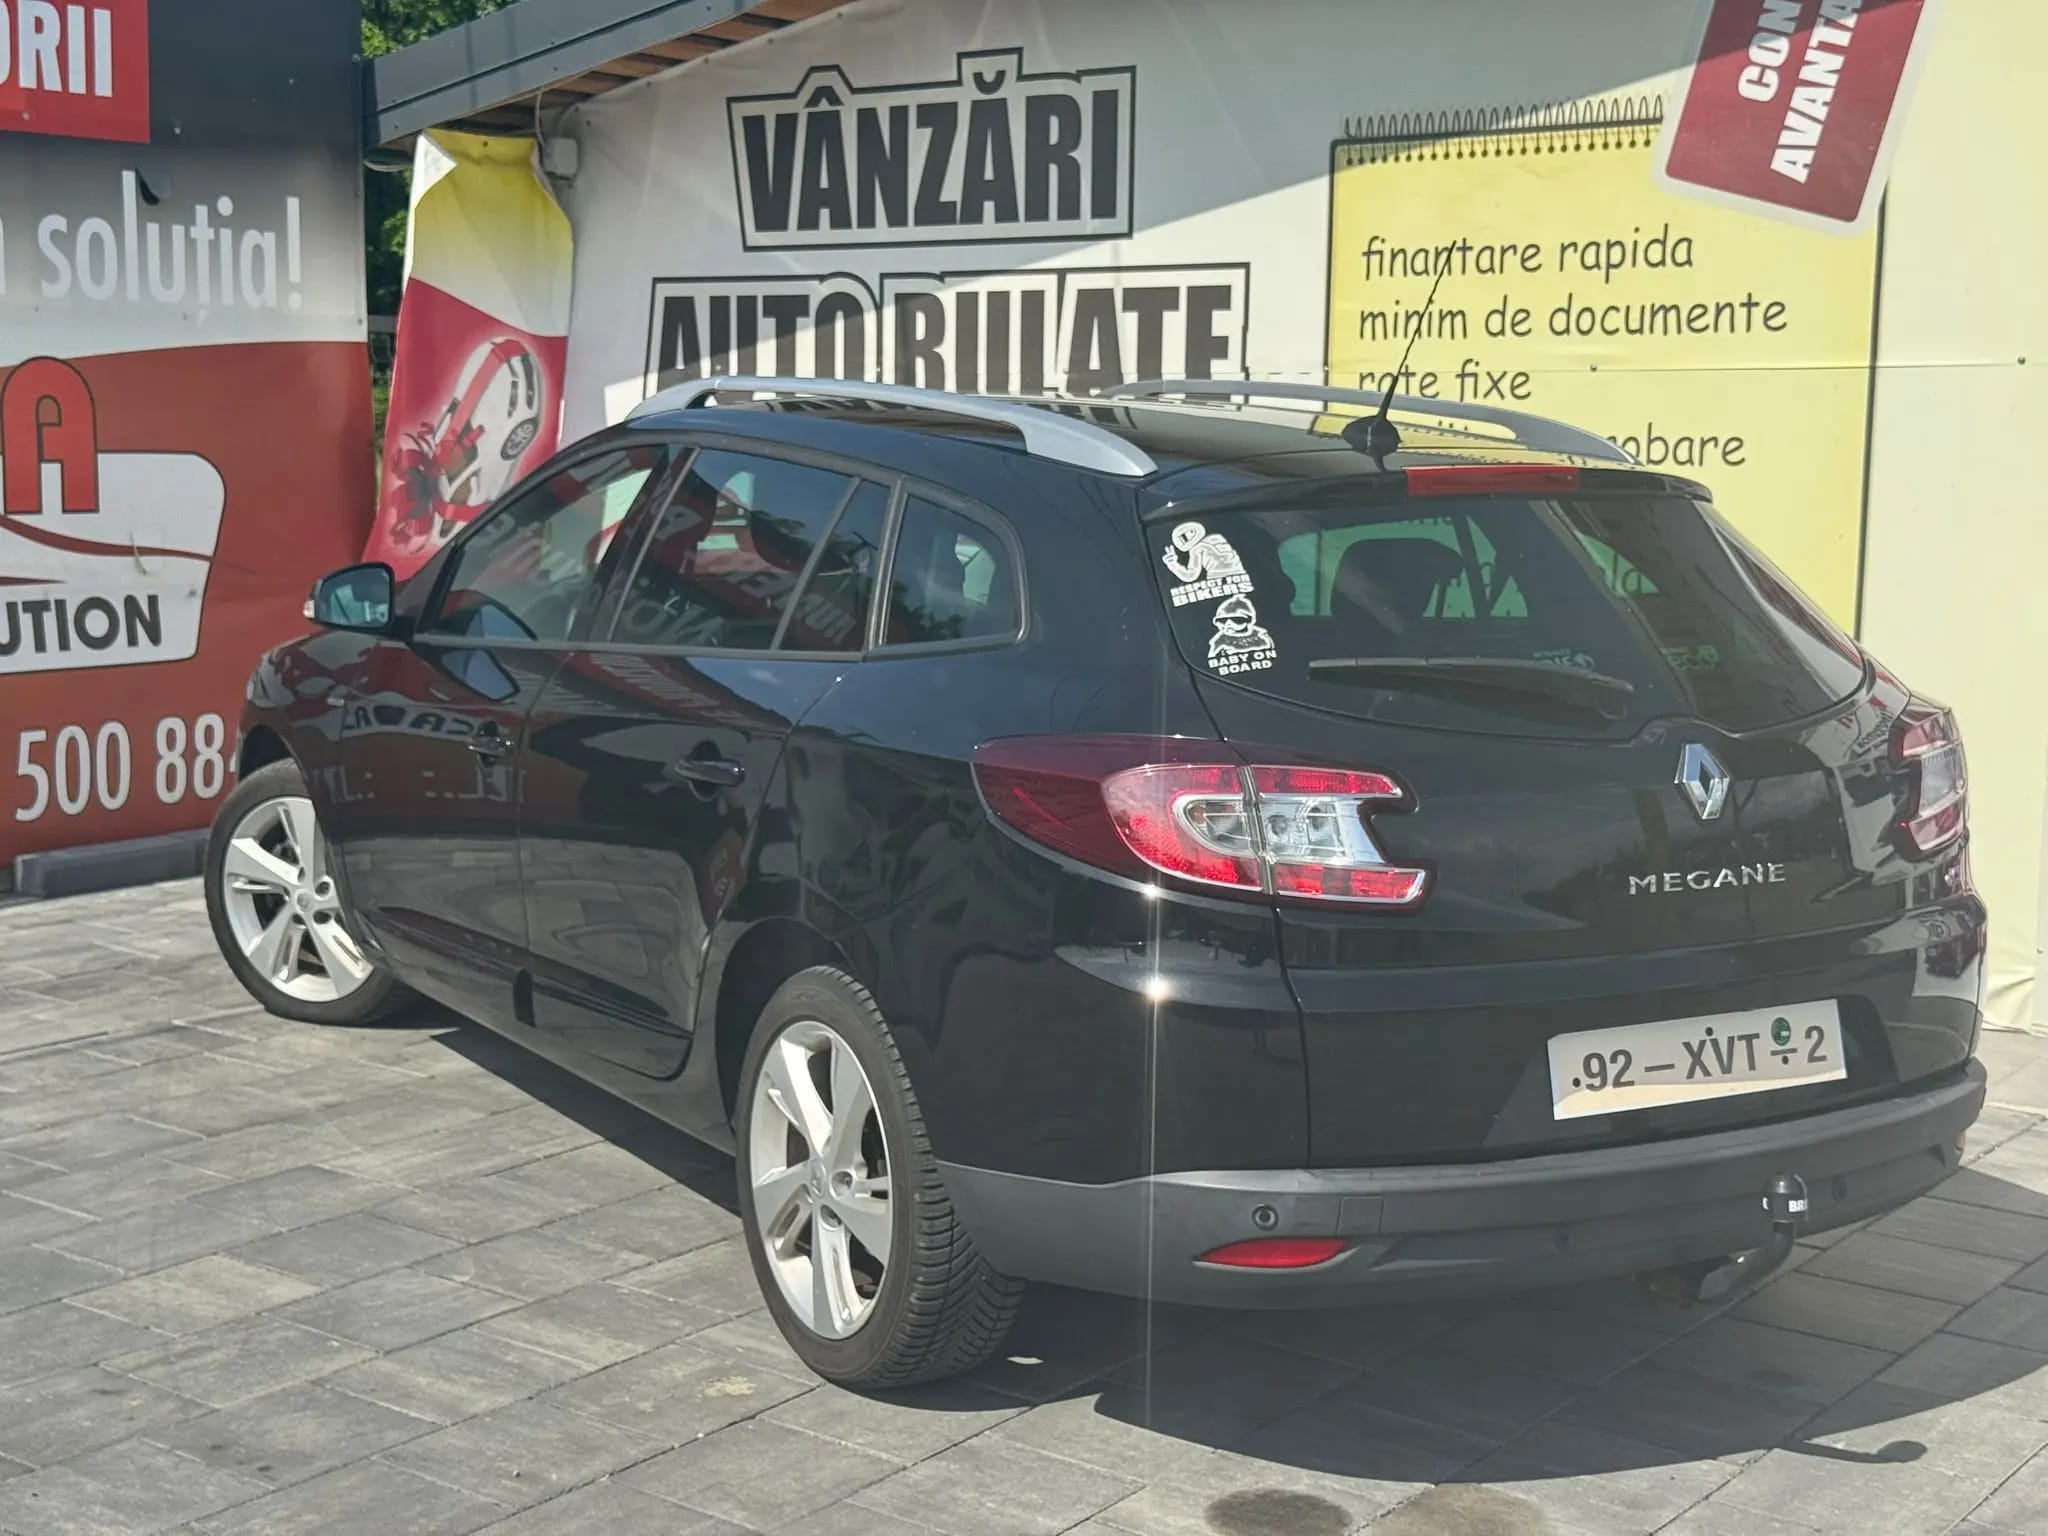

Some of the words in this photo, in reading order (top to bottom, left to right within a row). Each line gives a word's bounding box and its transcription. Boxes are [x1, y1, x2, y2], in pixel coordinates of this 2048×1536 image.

[0, 0, 113, 97] RII
[742, 69, 1120, 233] VÂNZĂRI
[1361, 235, 1543, 281] finantare
[1558, 222, 1693, 284] rapida
[1359, 298, 1467, 341] minim
[1484, 294, 1532, 338] de
[1549, 291, 1788, 336] documente
[1455, 358, 1532, 403] fixe
[1172, 582, 1255, 607] BIKERS
[1208, 653, 1249, 669] BABY
[1253, 649, 1278, 661] ON
[1219, 659, 1273, 676] BOARD
[15, 721, 132, 822] 500
[156, 713, 237, 804] 88
[1628, 862, 1787, 895] MEGANE
